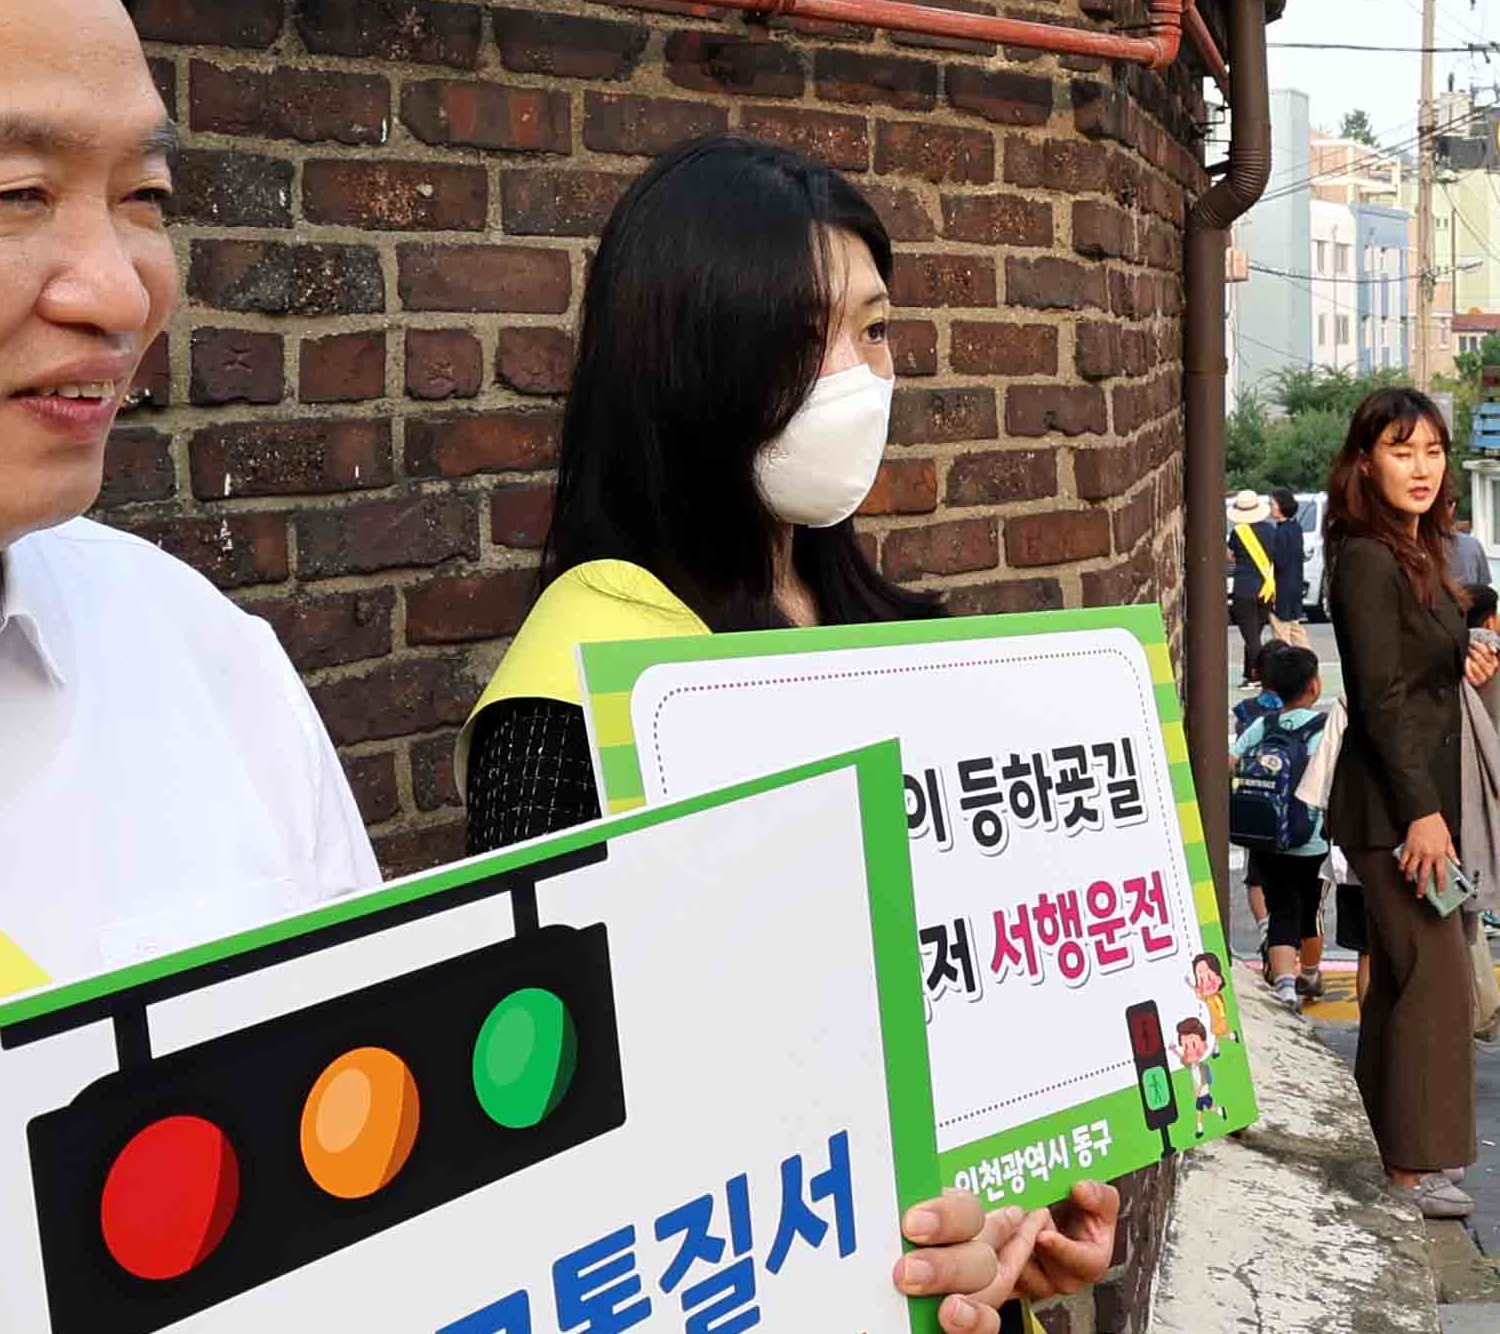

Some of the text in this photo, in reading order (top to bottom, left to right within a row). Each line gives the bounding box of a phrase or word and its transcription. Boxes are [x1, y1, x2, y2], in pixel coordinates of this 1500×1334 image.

[905, 736, 1144, 848] 이 등하굣길
[919, 871, 1175, 994] 저 서행운전
[954, 1119, 1113, 1199] 인천광역시 동구
